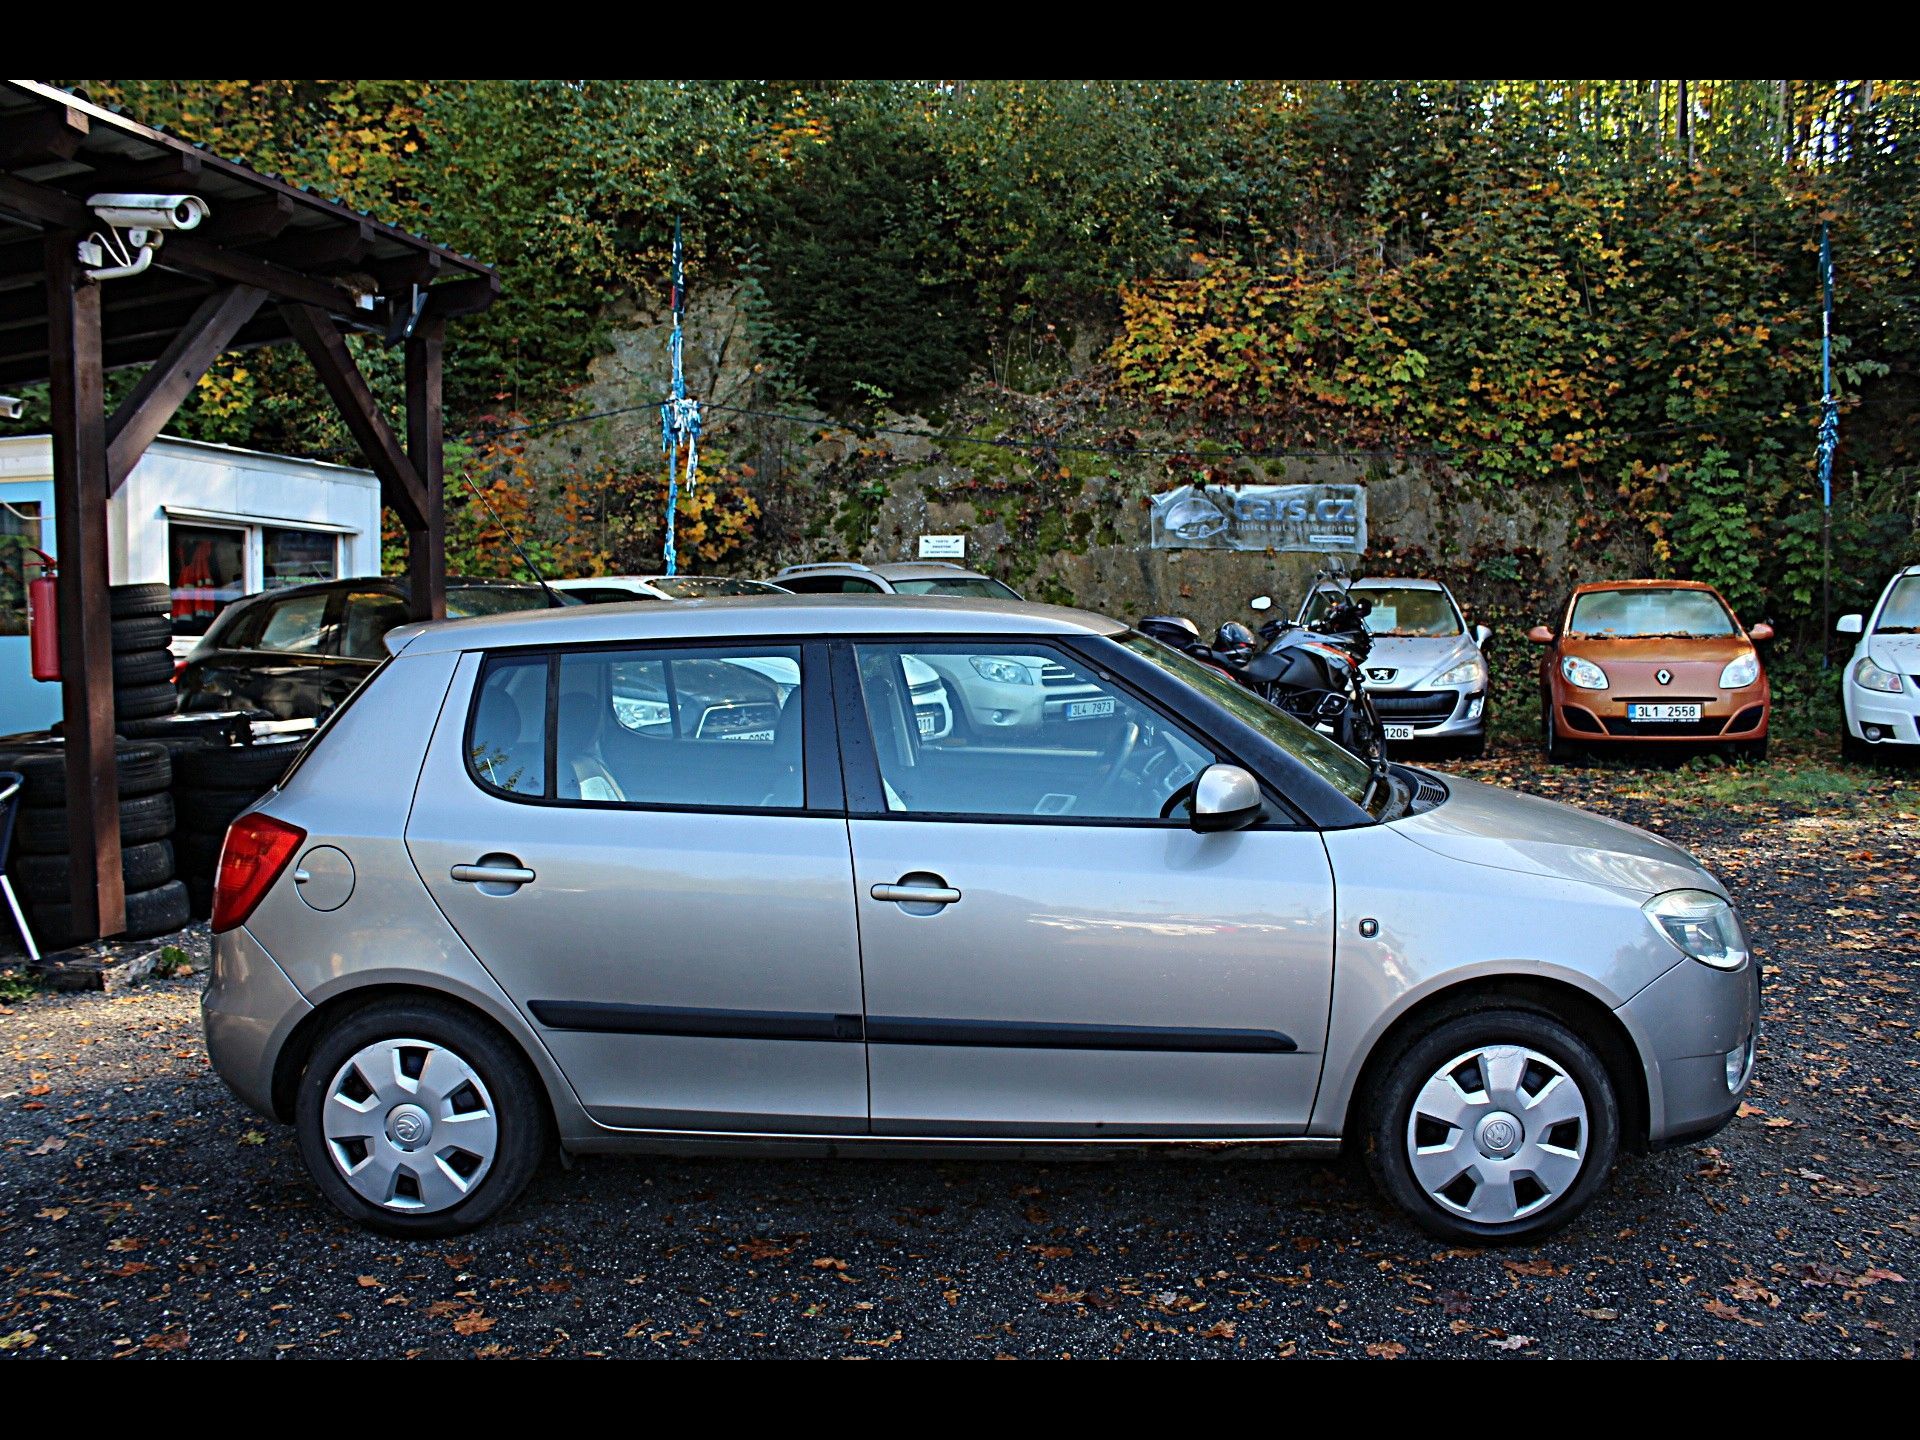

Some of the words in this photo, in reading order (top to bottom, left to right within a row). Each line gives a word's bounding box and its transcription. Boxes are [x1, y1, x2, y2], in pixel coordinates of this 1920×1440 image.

[1234, 499, 1354, 522] cars.cz
[1072, 703, 1086, 716] 3L4
[1092, 701, 1111, 713] 7973
[1638, 706, 1659, 717] 3L1
[1667, 706, 1696, 717] 2558
[1384, 727, 1409, 738] 1206
